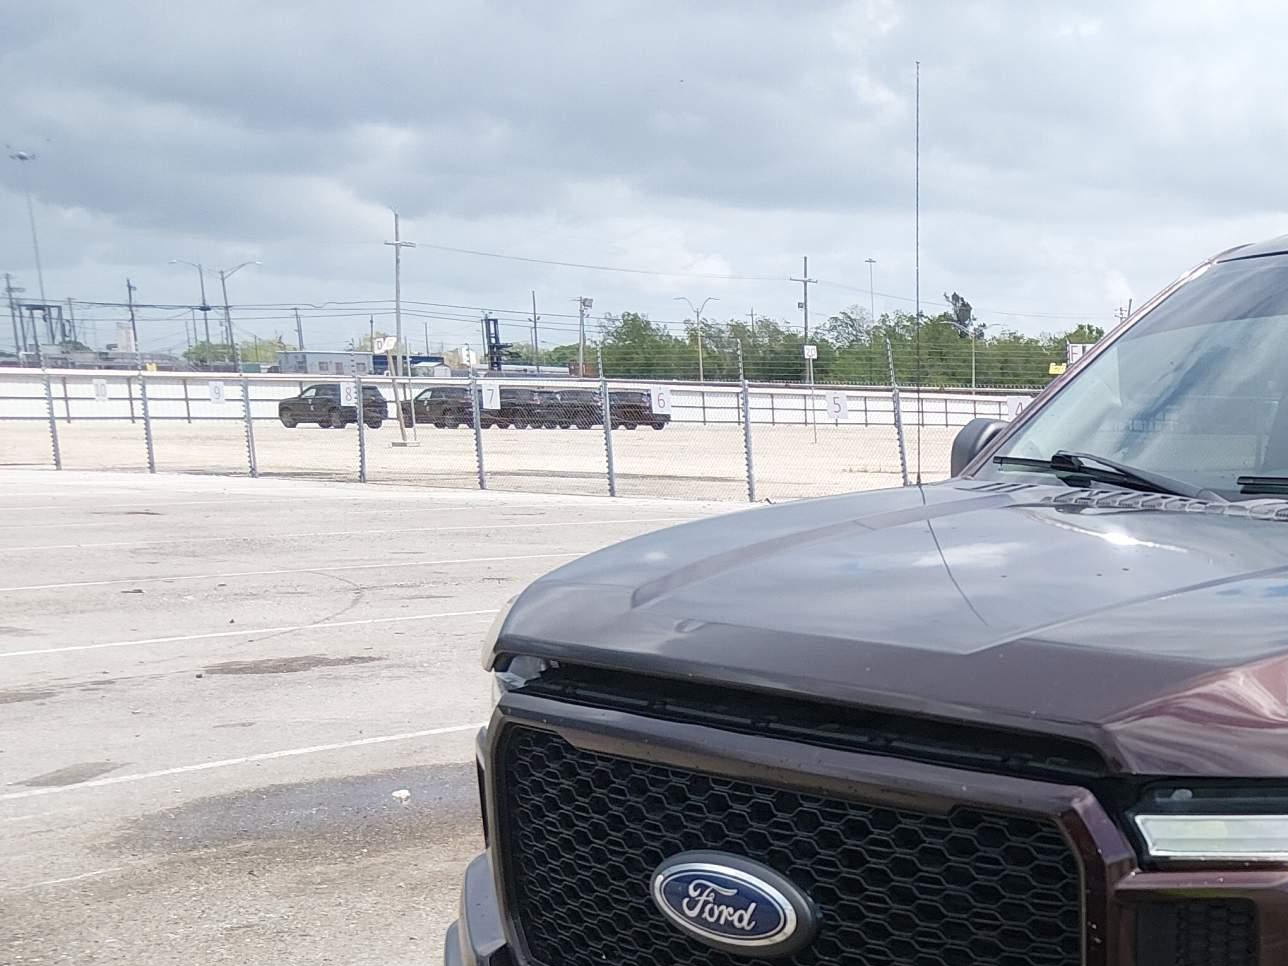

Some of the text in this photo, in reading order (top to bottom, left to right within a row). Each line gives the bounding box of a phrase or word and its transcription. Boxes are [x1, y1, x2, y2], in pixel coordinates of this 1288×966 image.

[806, 348, 816, 357] 20
[214, 386, 221, 400] 9
[345, 387, 353, 401] 8
[657, 392, 666, 408] 6
[833, 396, 842, 413] 5
[681, 879, 757, 931] Ford
